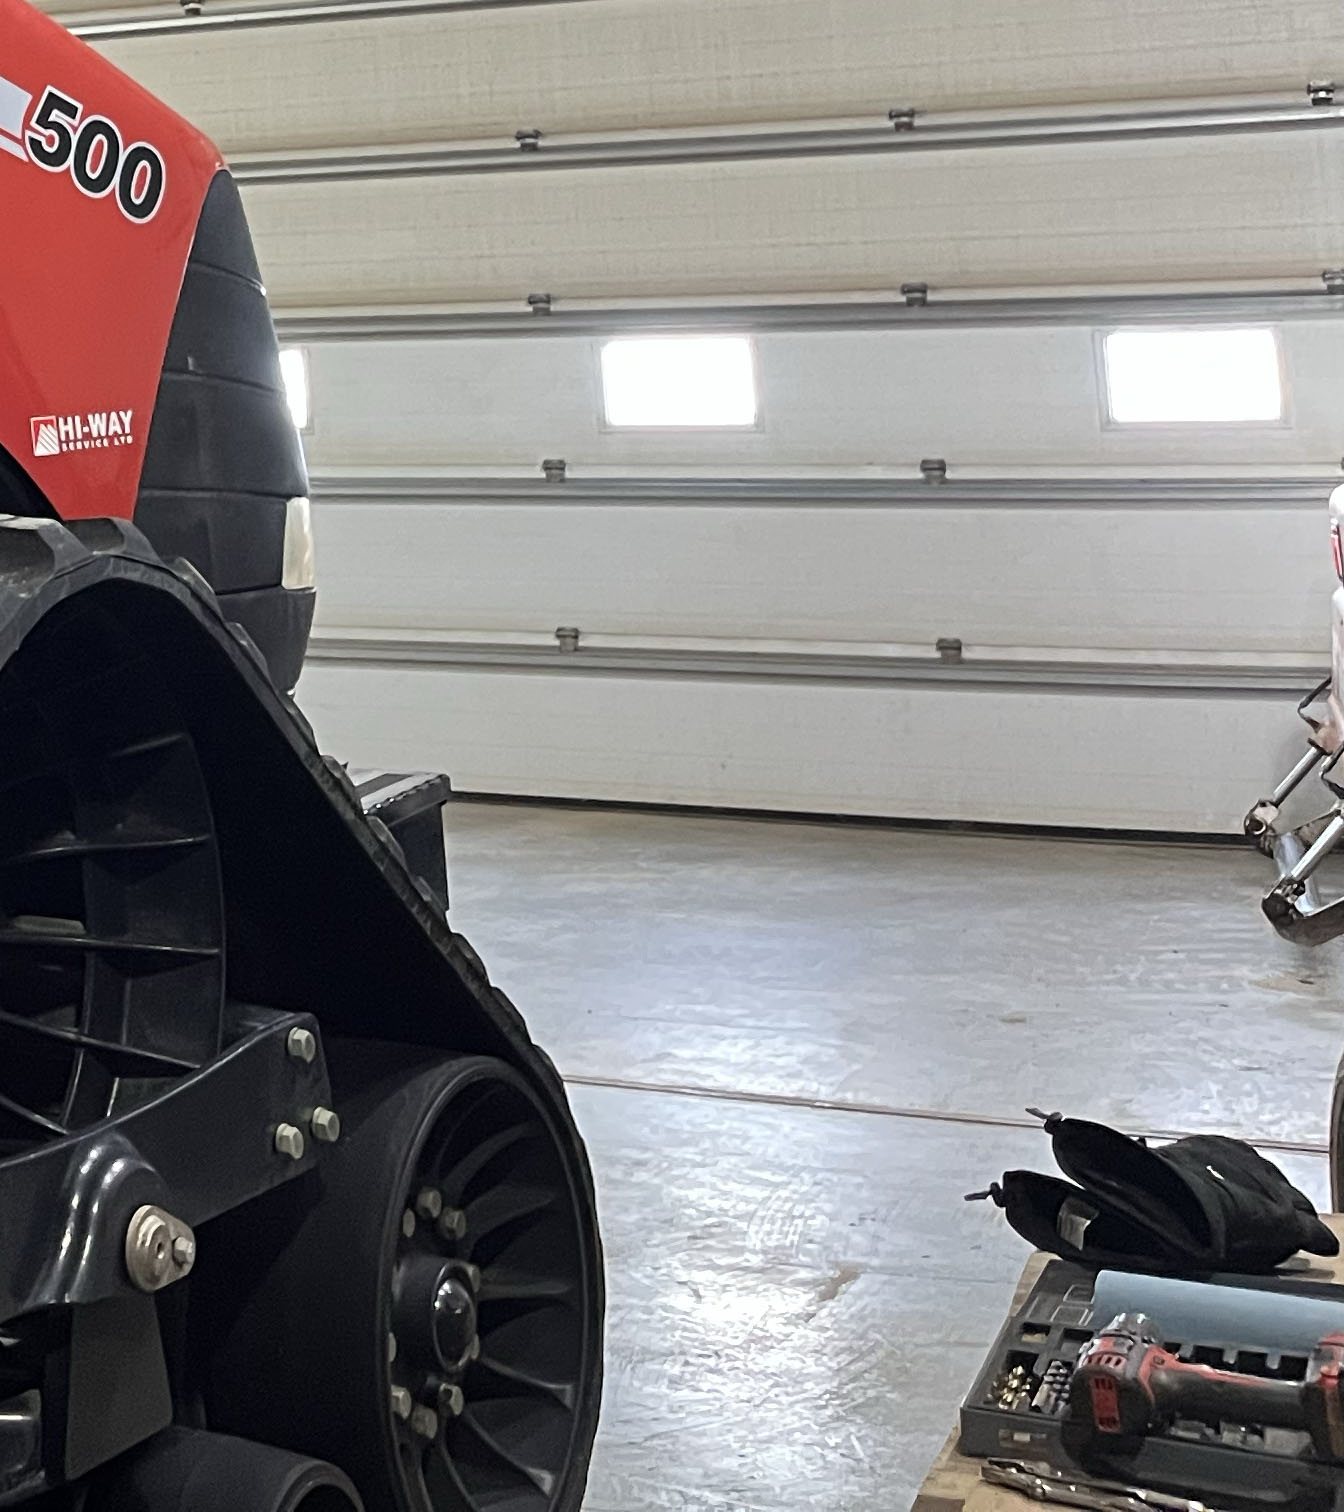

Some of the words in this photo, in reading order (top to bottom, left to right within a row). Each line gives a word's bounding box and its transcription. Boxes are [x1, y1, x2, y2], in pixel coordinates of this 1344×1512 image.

[25, 85, 165, 223] 500
[58, 410, 132, 441] HI-WAY
[62, 438, 109, 451] SERVICE
